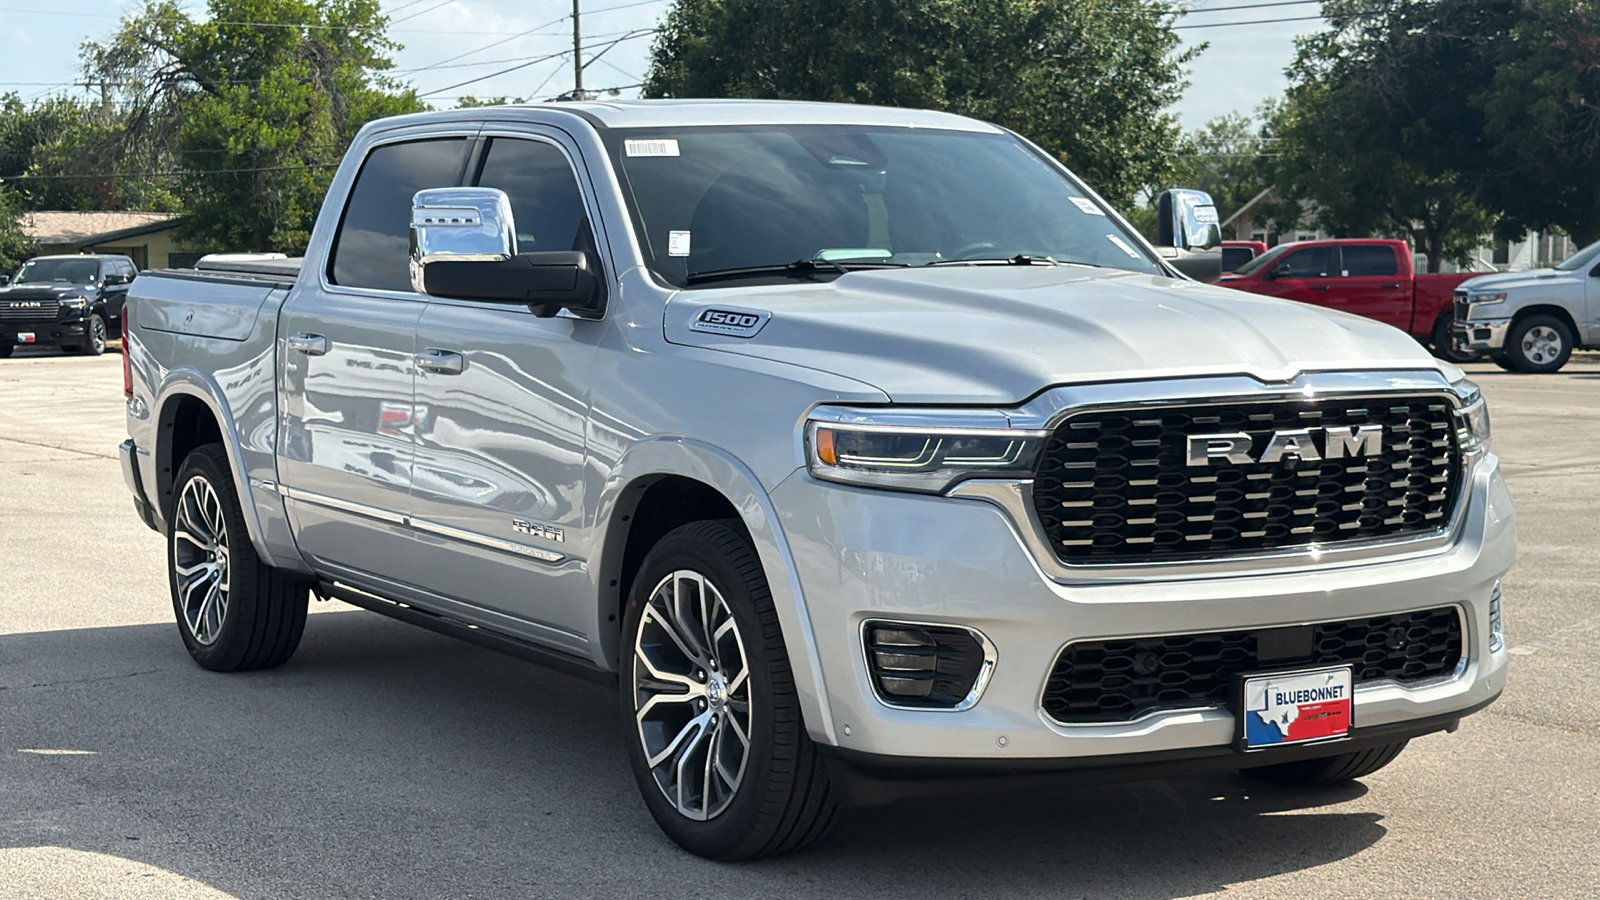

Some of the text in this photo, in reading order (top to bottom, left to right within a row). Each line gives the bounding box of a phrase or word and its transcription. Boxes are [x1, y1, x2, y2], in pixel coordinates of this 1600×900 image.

[704, 311, 757, 327] 1500
[1186, 425, 1383, 467] RAM
[512, 518, 565, 543] RAM
[1275, 685, 1344, 706] BLUEBONNET
